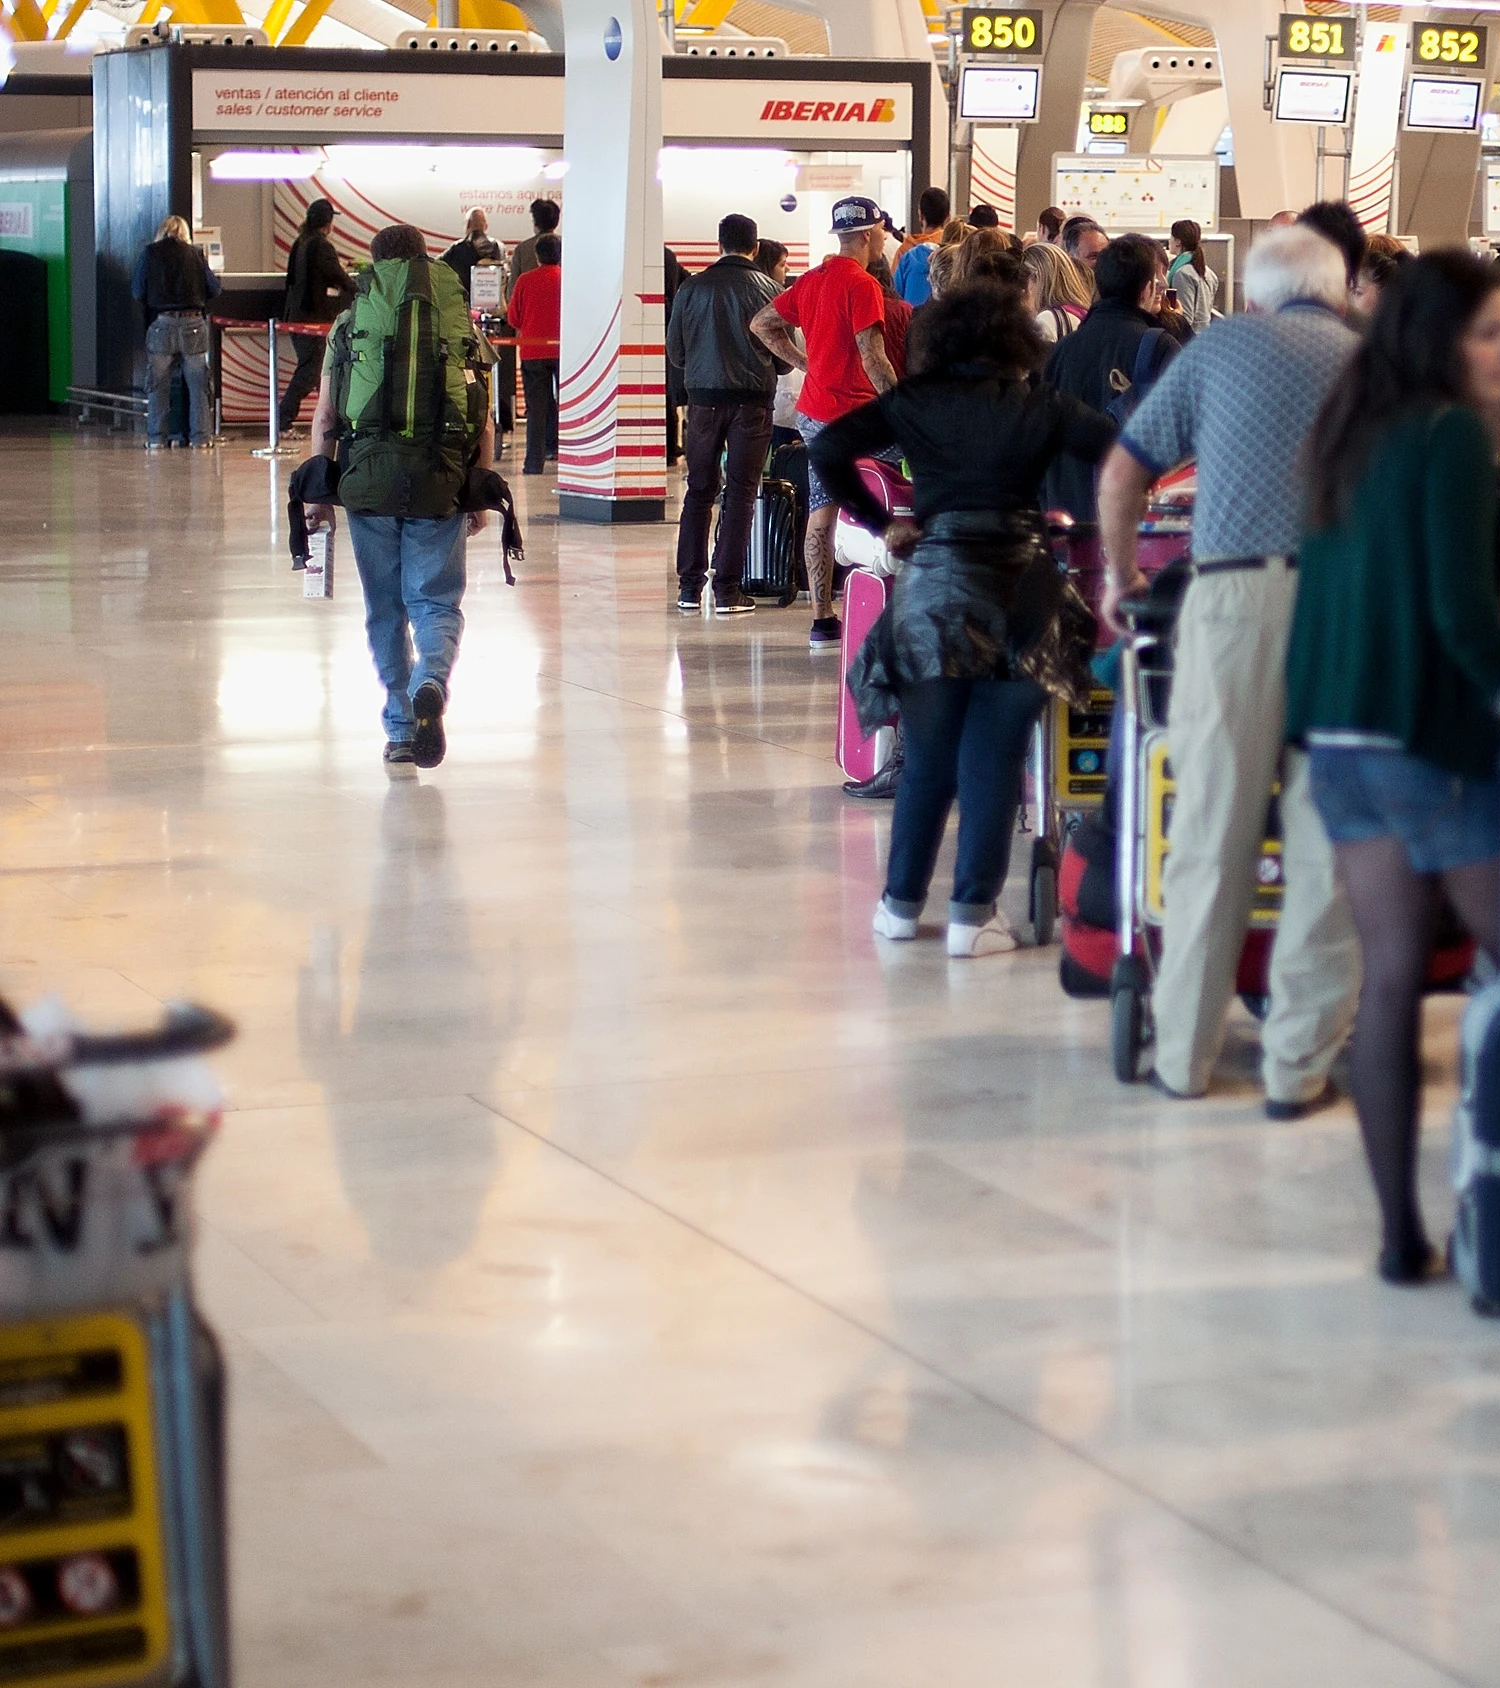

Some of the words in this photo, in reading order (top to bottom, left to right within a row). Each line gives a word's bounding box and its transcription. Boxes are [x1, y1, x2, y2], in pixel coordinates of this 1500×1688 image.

[971, 16, 1035, 48] 850
[1289, 21, 1344, 54] 851
[1419, 29, 1479, 62] 852
[215, 88, 261, 99] ventas
[275, 87, 334, 100] atención
[338, 88, 349, 100] al
[354, 89, 399, 101] cliente
[216, 103, 252, 115] sales
[265, 104, 329, 116] customer
[333, 105, 382, 117] service
[760, 100, 865, 122] IBERIA
[459, 188, 512, 200] estamos
[496, 203, 525, 215] here
